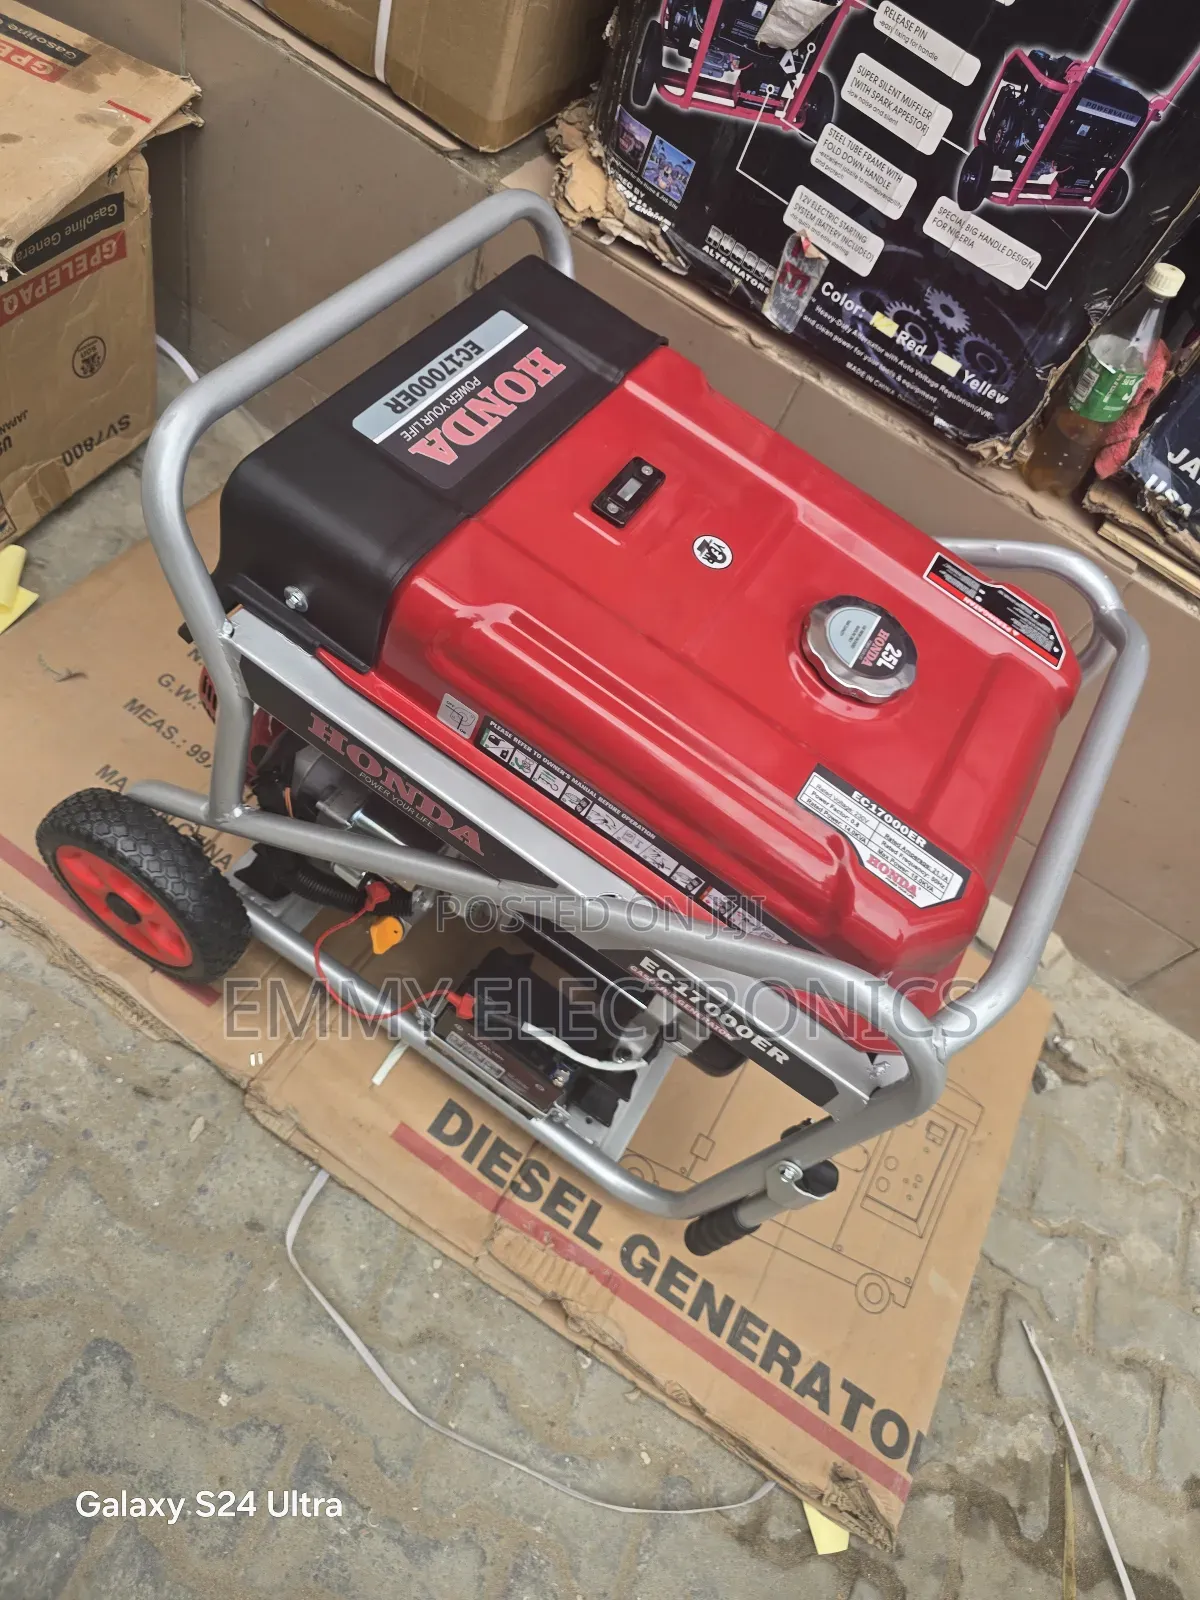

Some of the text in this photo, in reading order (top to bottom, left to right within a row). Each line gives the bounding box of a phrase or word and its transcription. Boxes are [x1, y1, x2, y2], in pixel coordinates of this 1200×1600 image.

[6, 22, 79, 62] Gasoline
[884, 6, 928, 40] RELEASE PIN
[894, 28, 909, 43] fixing
[909, 38, 919, 48] for
[917, 43, 938, 62] handle
[857, 65, 932, 120] SUPER SILENT MUFFLER
[858, 96, 872, 108] noise
[872, 105, 885, 116] and
[871, 89, 893, 110] SPARK
[1086, 101, 1137, 122] POWERVALUE
[822, 139, 892, 190] FOLD DOWN HANDLE
[828, 128, 903, 183] STEEL TUBE FRAME WITH
[14, 202, 118, 263] Gasoline Genera
[793, 202, 816, 222] SYSTEM
[810, 200, 838, 225] ELECTRIC
[838, 218, 867, 243] STARTING
[932, 216, 975, 250] FOR NIGERIA
[937, 206, 1035, 270] SPECIAL BIG HANDLE DESIGN
[2, 239, 118, 317] GPELEPAQ
[702, 245, 770, 294] ALTERNATORS
[821, 282, 866, 318] Color:
[897, 331, 928, 358] Red
[384, 340, 485, 414] EC17000ER
[846, 361, 866, 376] MADE
[853, 344, 864, 356] for
[895, 372, 902, 382] &
[884, 348, 899, 365] with
[898, 358, 914, 376] Auto
[914, 368, 940, 393] Voltage
[400, 376, 482, 442] POWER YOUR LIFE
[408, 346, 566, 466] HONDA
[62, 413, 132, 468] SV7800
[1168, 448, 1200, 486] JA
[861, 628, 890, 667] HONDA
[876, 643, 902, 670] 25L
[308, 712, 485, 856] HONDA
[360, 771, 434, 829] POWER YOUR LIFE
[489, 720, 513, 742] PLEASE
[512, 736, 532, 754] REFER
[532, 748, 542, 759] TO
[542, 754, 571, 780] OWNER'S
[571, 775, 598, 799] MANUAL
[598, 792, 622, 814] BEFORE
[621, 810, 656, 840] OPERATION
[816, 784, 832, 798] Rated
[807, 798, 823, 813] Rated
[824, 808, 842, 827] Power:
[811, 790, 860, 828] Power Factor: 0.8
[851, 790, 927, 848] EC17000ER
[877, 848, 888, 861] Max
[890, 857, 910, 876] Power:
[881, 840, 898, 856] Rated
[898, 852, 930, 880] Frequency:
[884, 833, 901, 848] Rated
[867, 854, 917, 896] HONDA
[629, 964, 738, 1042] GASOLINE GENERATOR
[640, 956, 791, 1065] EC17000ER
[426, 1098, 604, 1250] DIESEL
